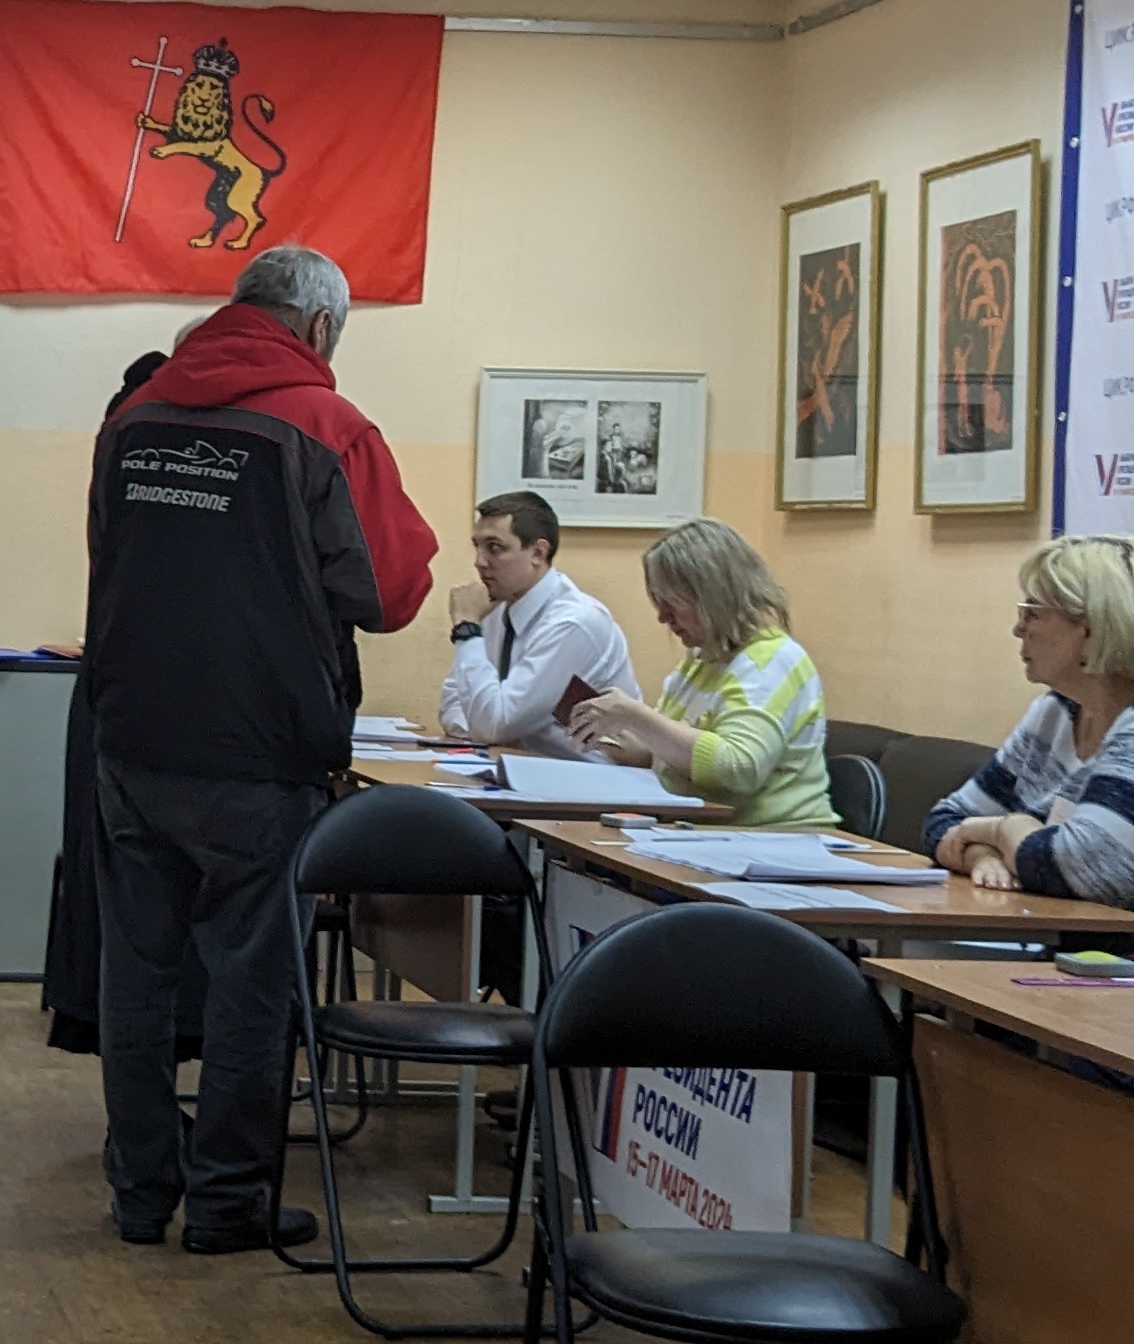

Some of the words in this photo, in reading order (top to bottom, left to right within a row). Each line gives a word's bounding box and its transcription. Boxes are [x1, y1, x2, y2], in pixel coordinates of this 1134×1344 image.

[122, 459, 162, 471] POLE
[165, 462, 239, 482] POSITION
[126, 482, 232, 513] BRIDGESTONE
[632, 1083, 703, 1160] РОССИИ
[658, 1159, 699, 1220] МАРТА
[698, 1188, 734, 1231] 2024
